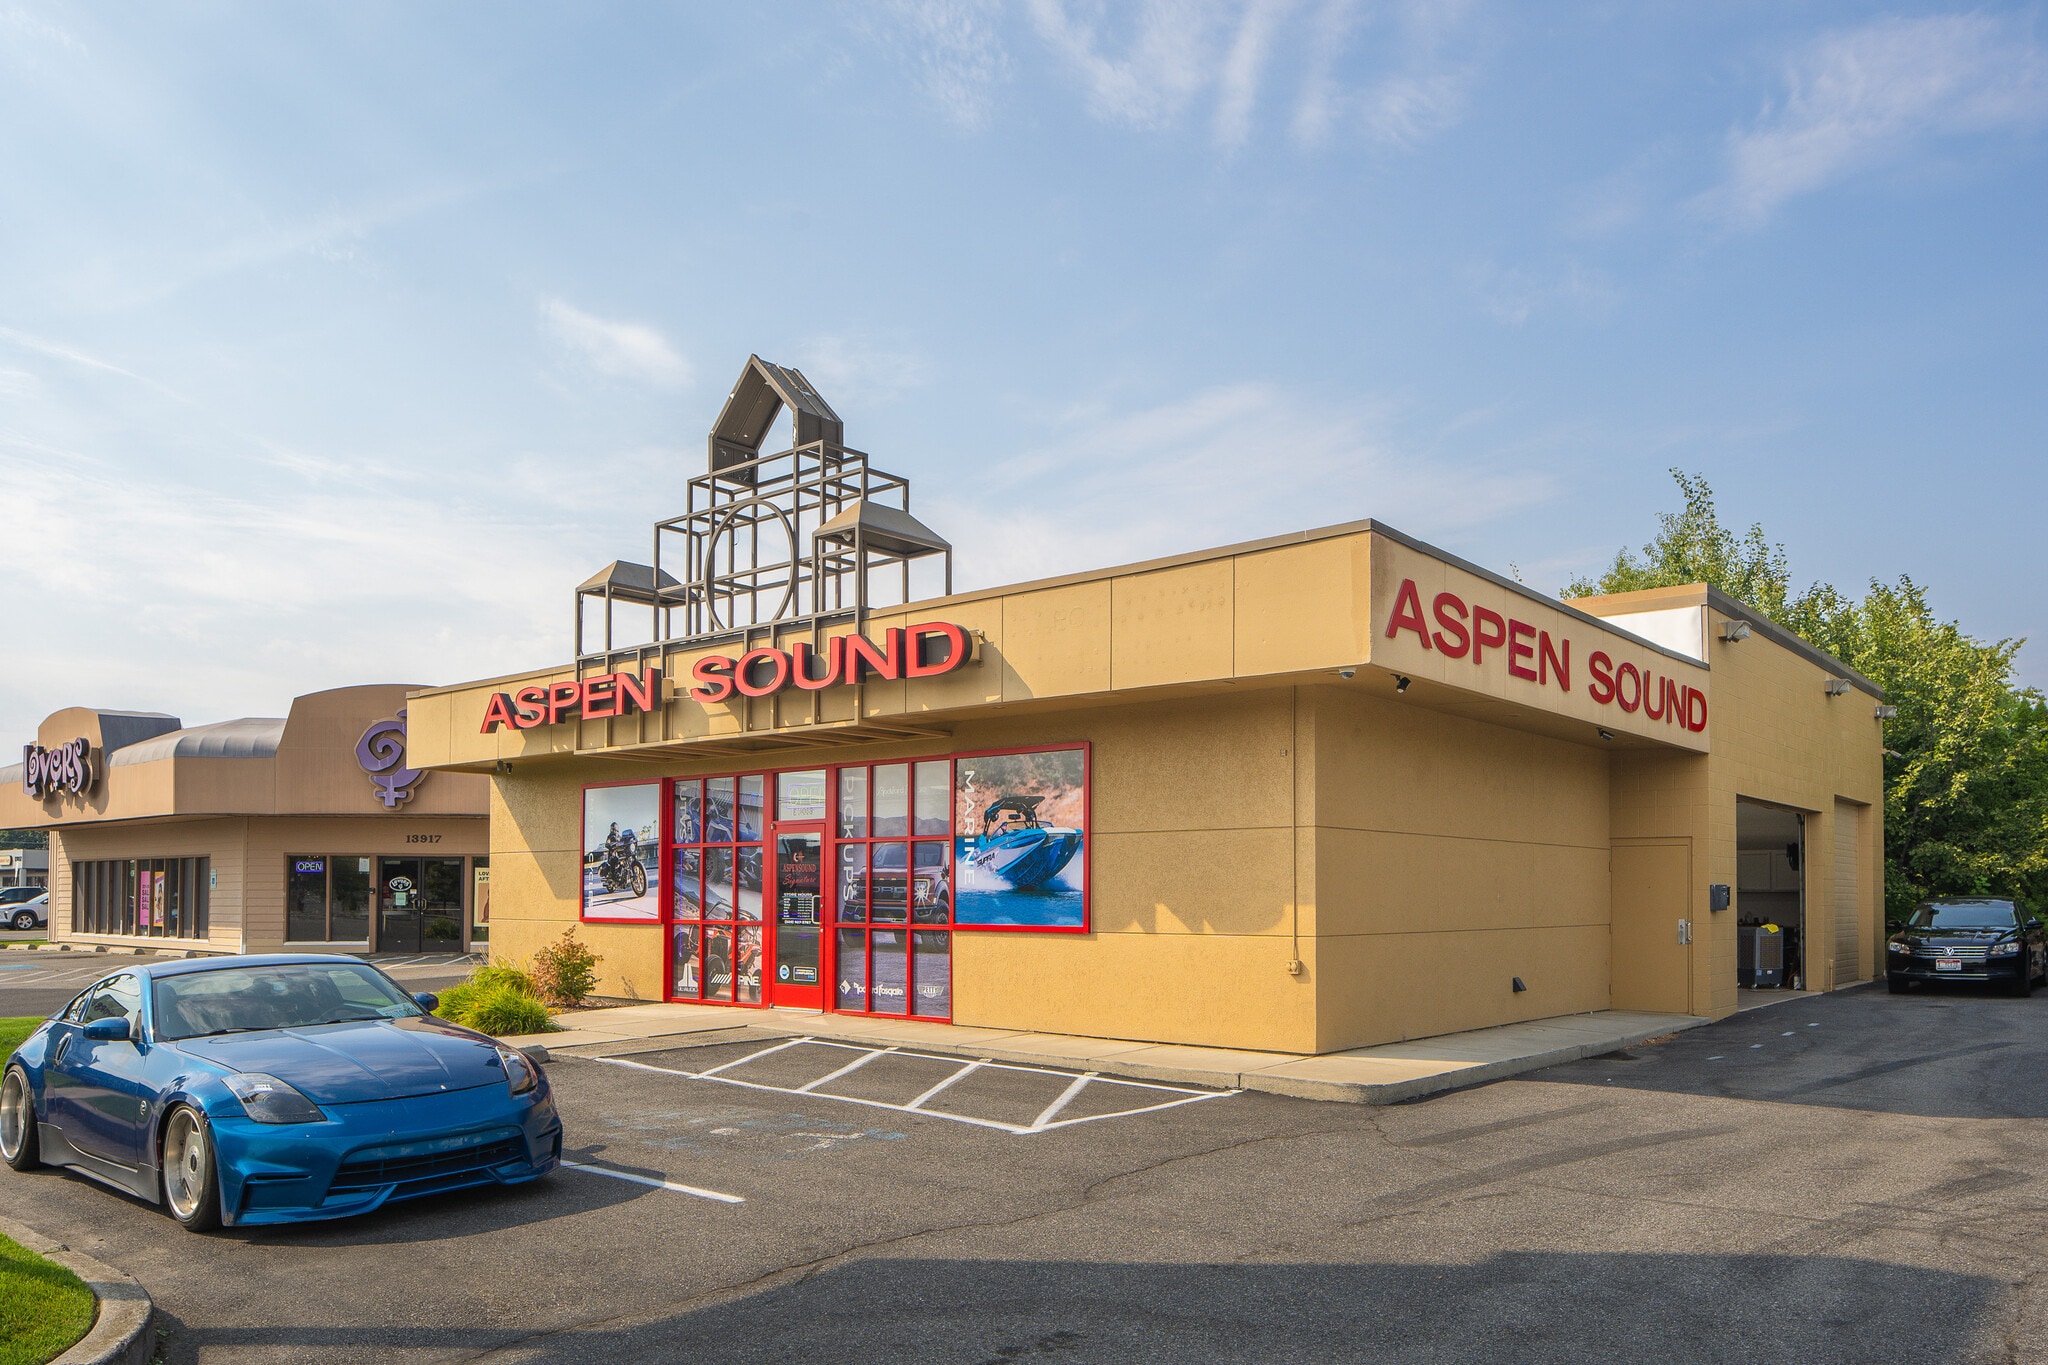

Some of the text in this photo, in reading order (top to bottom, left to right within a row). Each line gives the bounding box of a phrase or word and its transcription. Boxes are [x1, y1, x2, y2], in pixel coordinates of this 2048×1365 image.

[480, 621, 969, 734] ASPEN SOUND
[1386, 578, 1708, 733] ASPEN SOUND
[297, 861, 323, 872] OPEN
[405, 834, 443, 844] 13917
[843, 776, 854, 901] PICKUPS
[964, 770, 975, 885] MARINE
